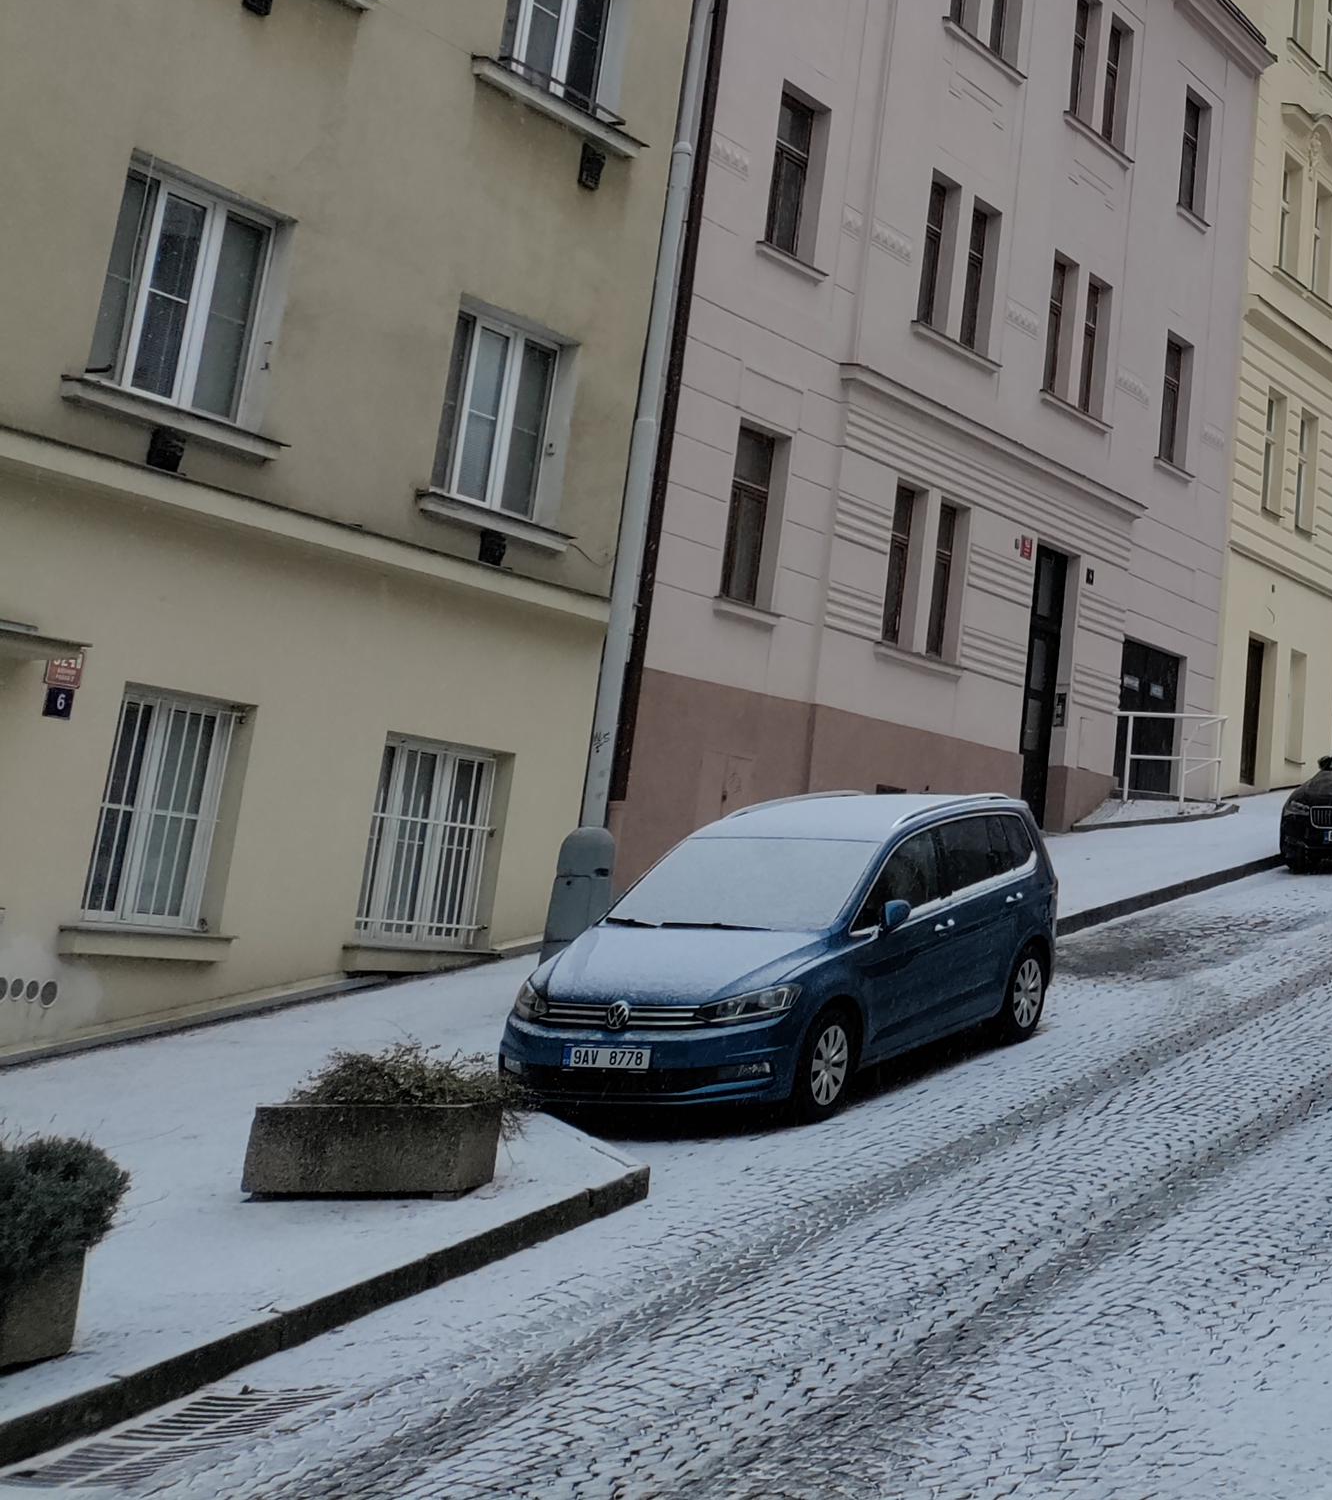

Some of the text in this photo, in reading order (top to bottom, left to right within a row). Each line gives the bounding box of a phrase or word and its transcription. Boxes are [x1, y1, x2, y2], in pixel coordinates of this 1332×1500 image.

[56, 693, 66, 710] 6
[573, 1050, 599, 1066] 9AV
[609, 1051, 643, 1066] 8778
